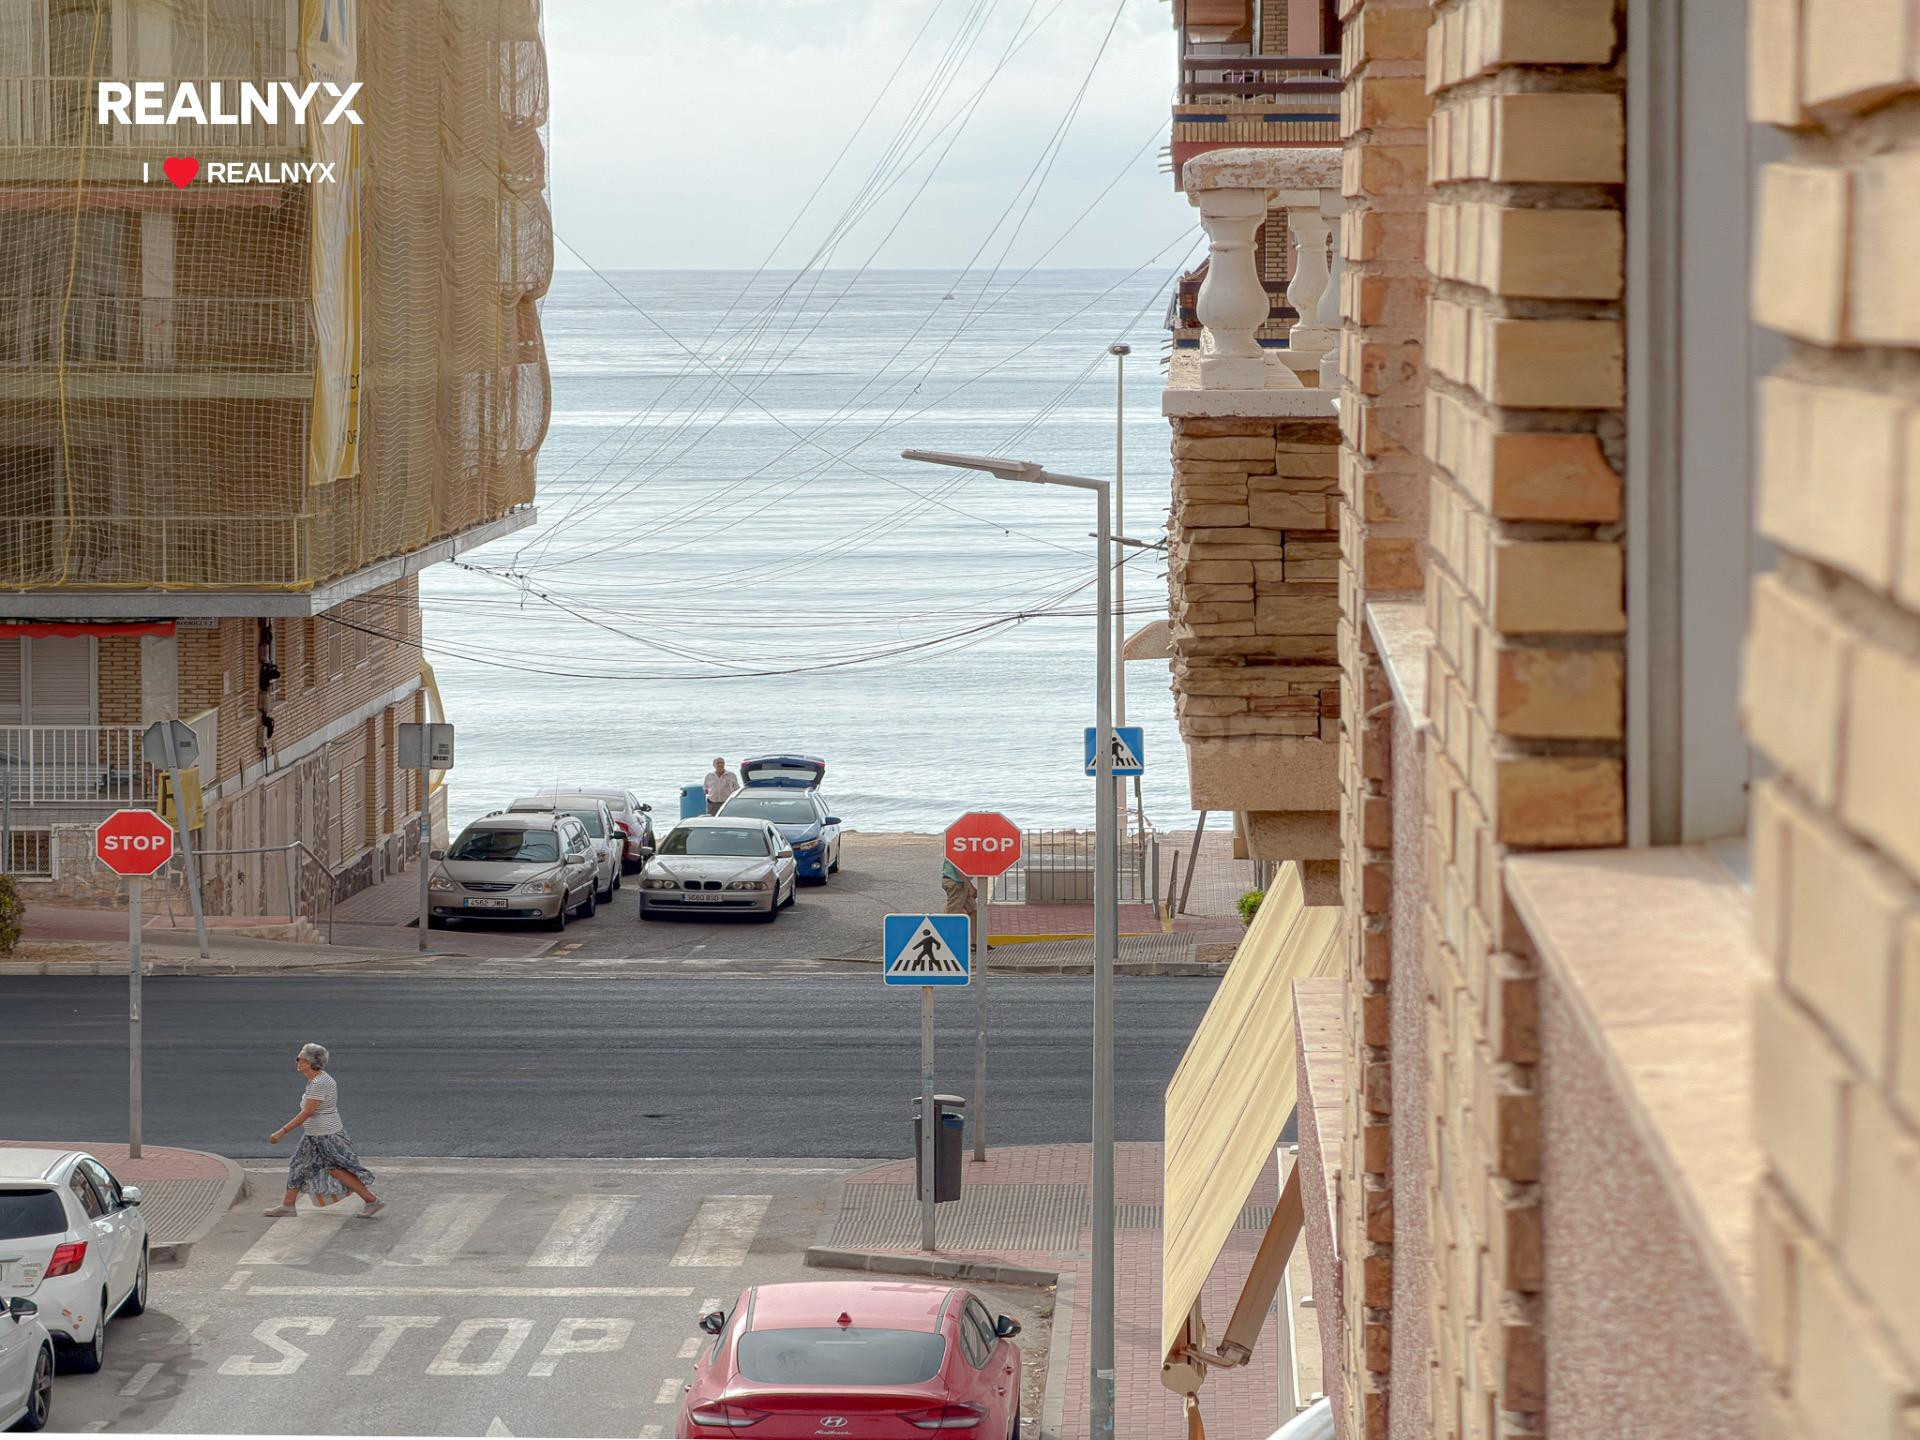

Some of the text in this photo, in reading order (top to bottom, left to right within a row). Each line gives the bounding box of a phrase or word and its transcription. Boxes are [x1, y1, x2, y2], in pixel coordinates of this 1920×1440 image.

[104, 835, 166, 851] STOP
[952, 836, 1015, 852] STOP
[217, 1315, 637, 1377] STOP
